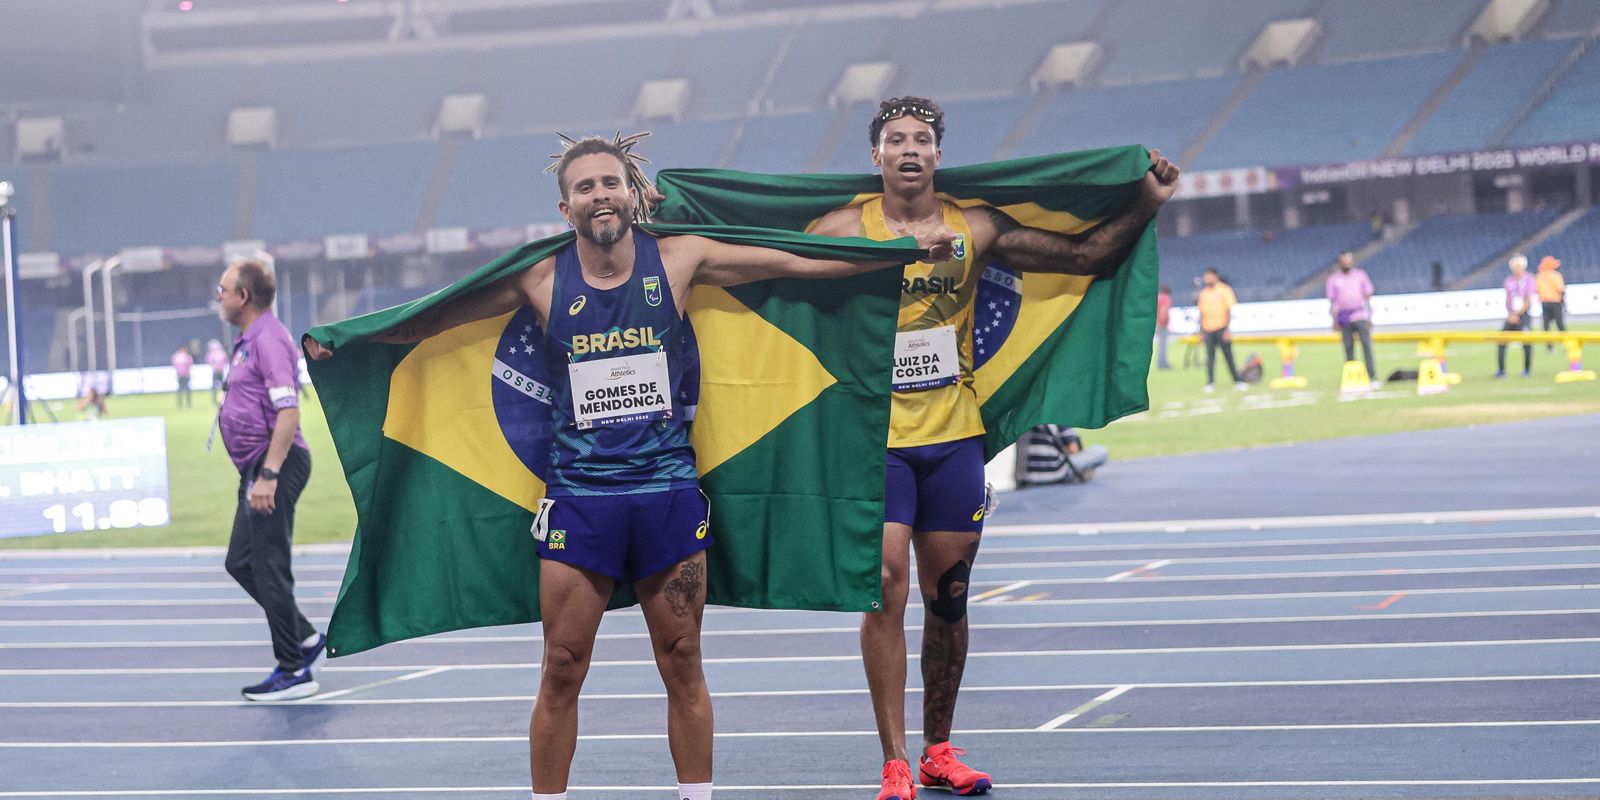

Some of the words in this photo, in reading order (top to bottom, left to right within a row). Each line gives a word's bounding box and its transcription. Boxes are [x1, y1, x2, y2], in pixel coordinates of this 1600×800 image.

[1370, 158, 1413, 179] NEW
[1415, 154, 1470, 175] DELHI
[1471, 151, 1515, 171] 2025
[1516, 144, 1587, 167] WORLD
[902, 276, 960, 294] RASIL
[572, 326, 661, 354] BRASIL
[893, 356, 920, 368] LUIZ
[922, 353, 940, 364] DA
[610, 369, 637, 378] Athletics
[896, 364, 940, 378] COSTA
[585, 385, 637, 401] GOMES
[639, 382, 658, 394] DE
[580, 394, 666, 415] MENDONCA
[548, 542, 565, 550] BRA
